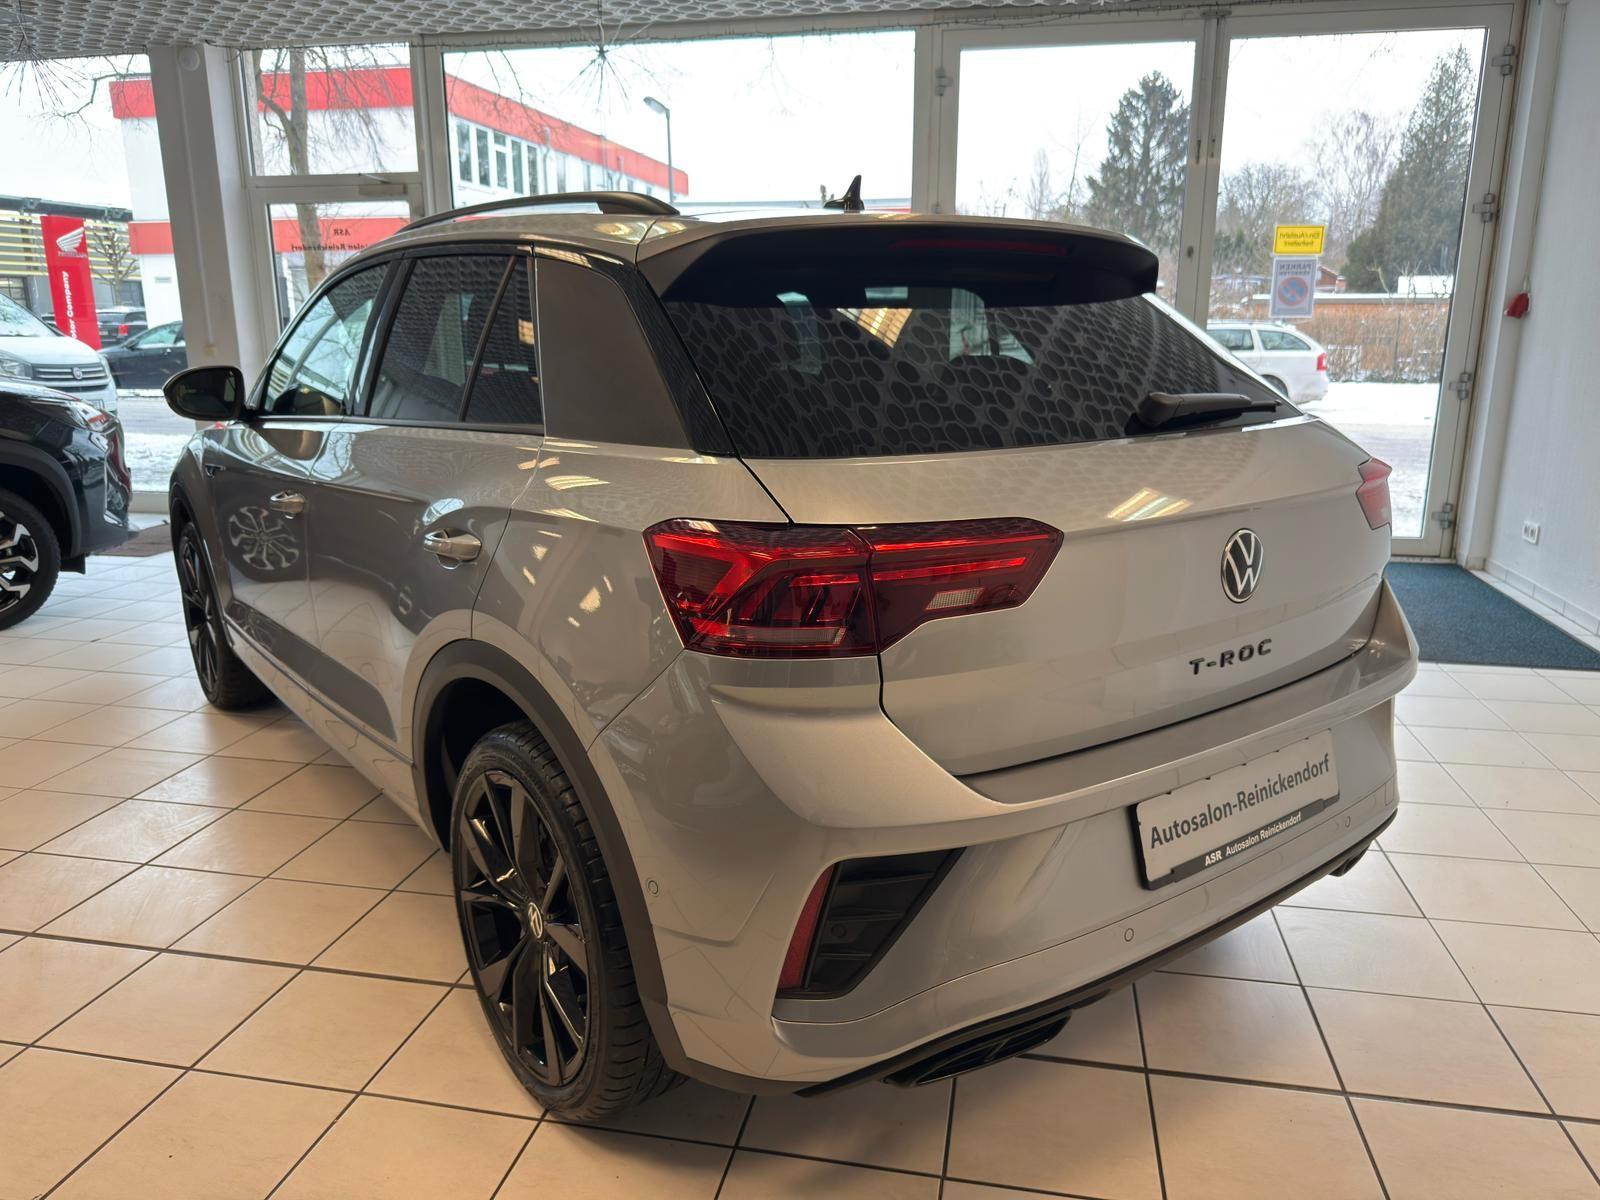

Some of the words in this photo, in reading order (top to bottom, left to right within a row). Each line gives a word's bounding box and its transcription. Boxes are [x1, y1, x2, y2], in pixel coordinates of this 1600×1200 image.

[61, 270, 74, 317] Company
[69, 318, 78, 340] otor
[1188, 638, 1273, 675] T-ROC
[1150, 752, 1330, 849] Autosalon-Reinickendorf
[1204, 850, 1223, 867] ASR
[1225, 834, 1260, 857] Autosalon
[1259, 812, 1302, 840] Reinickendorf
